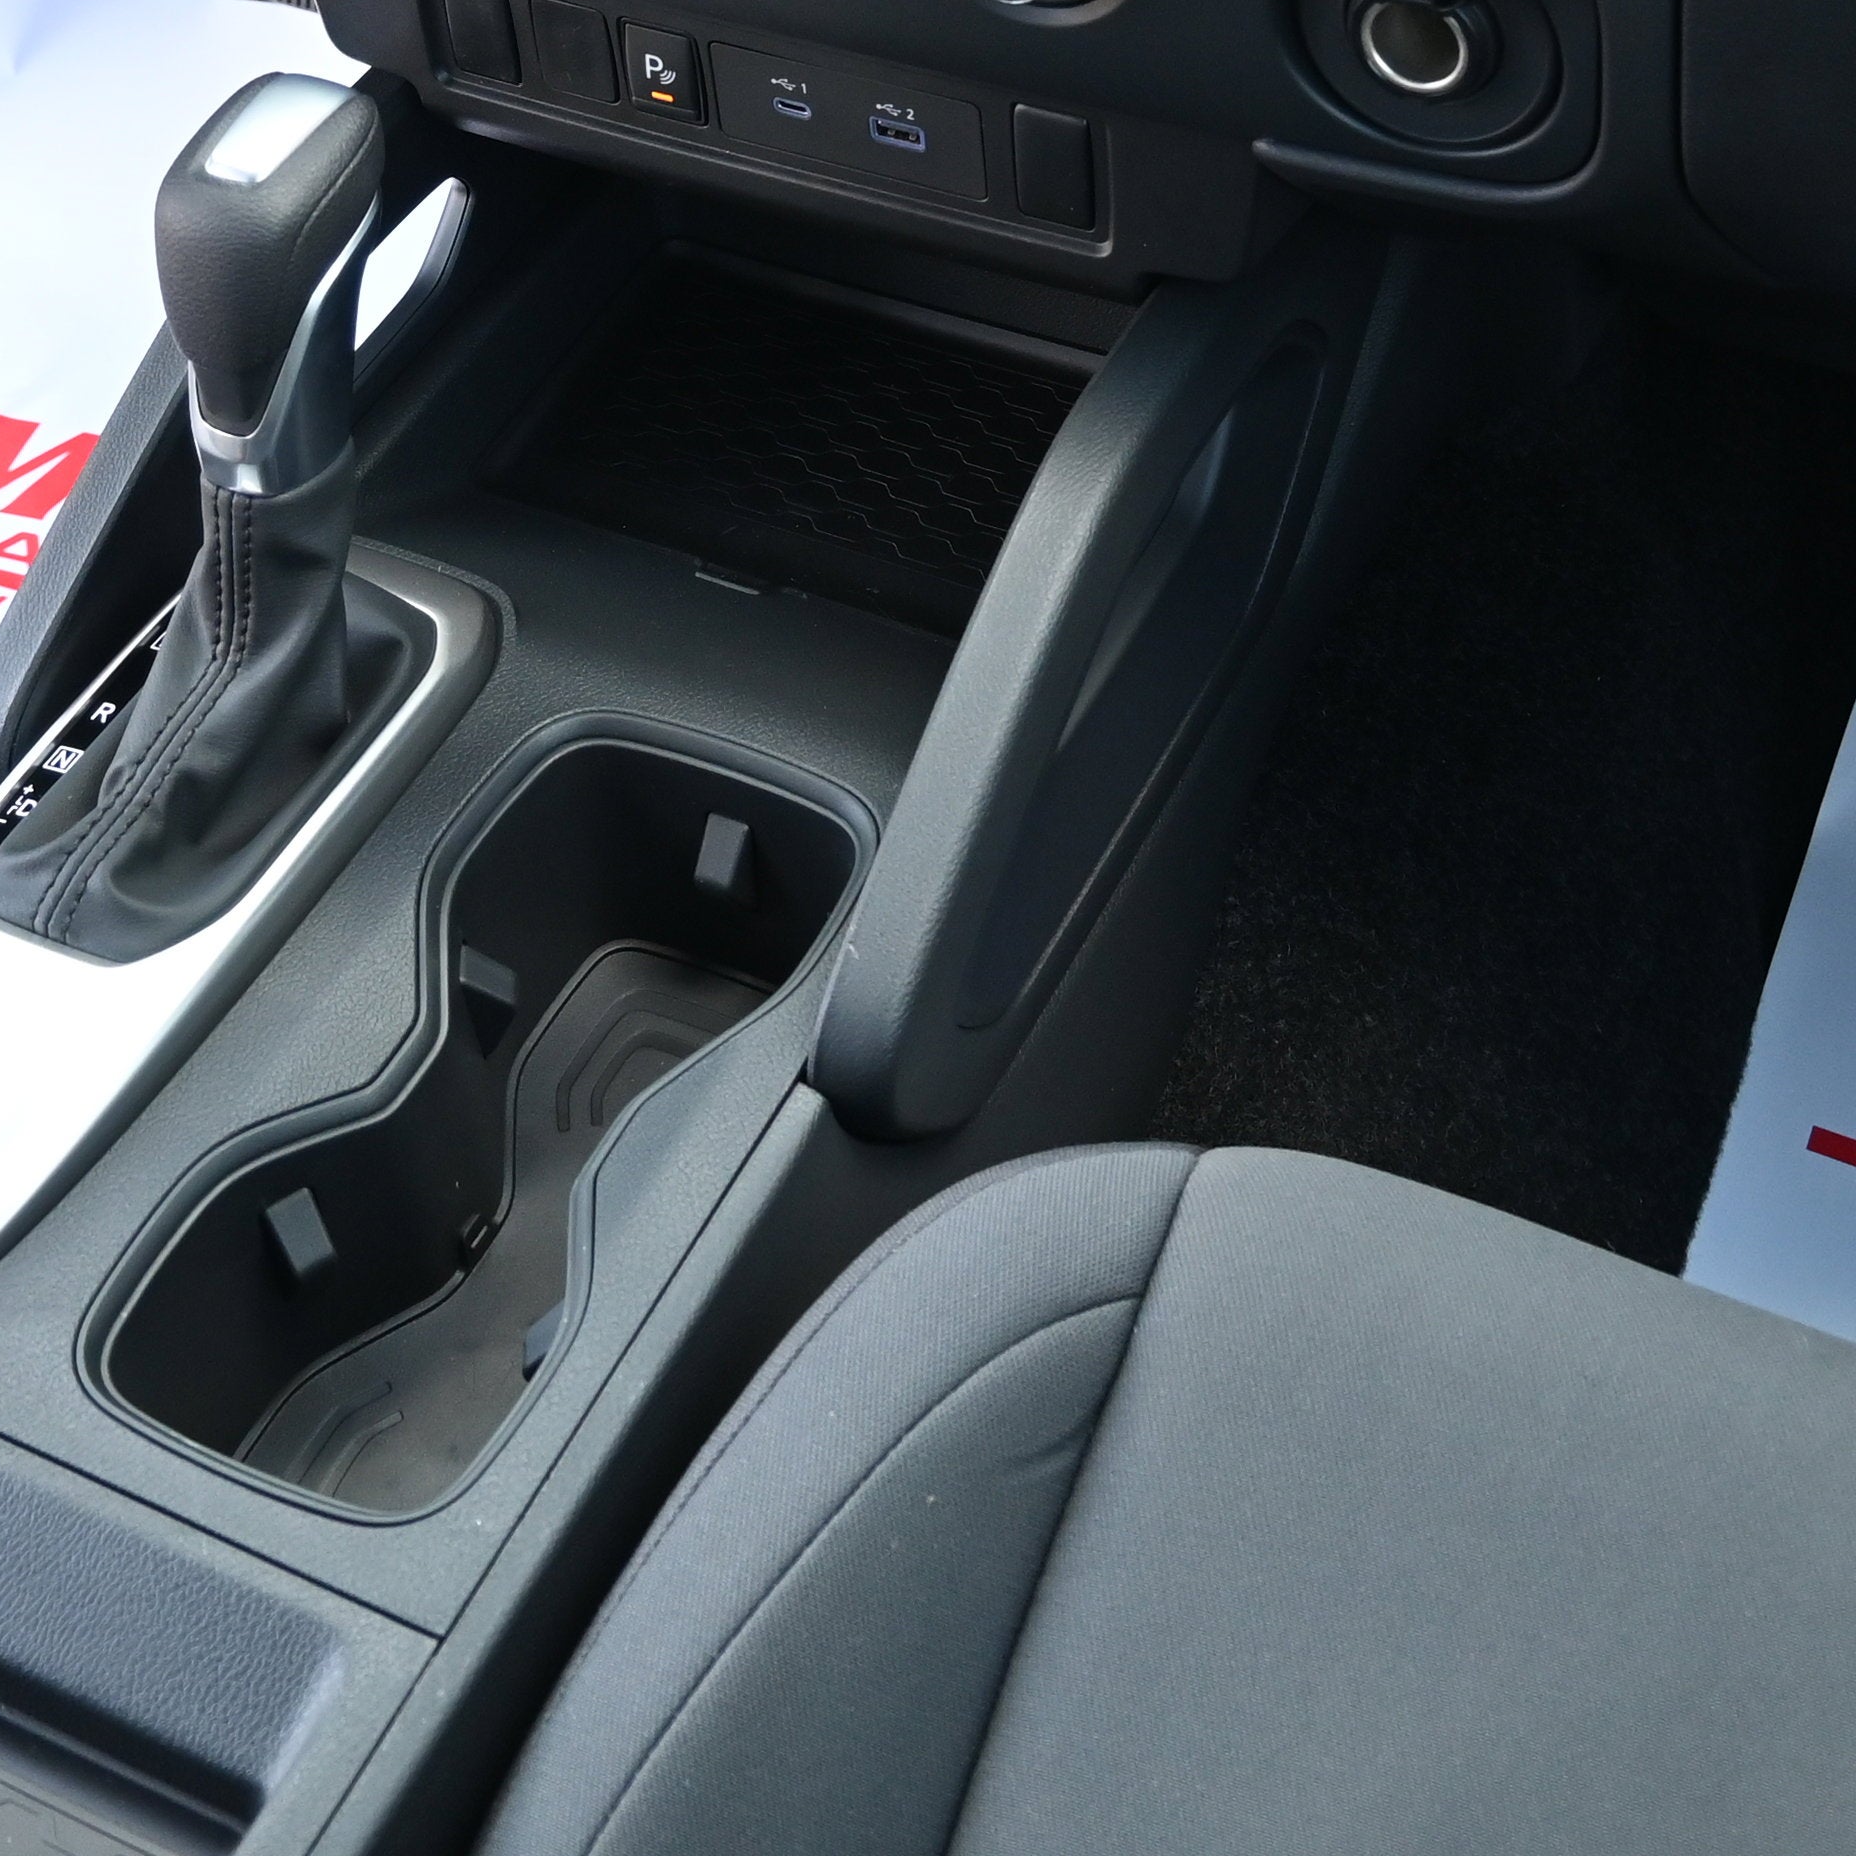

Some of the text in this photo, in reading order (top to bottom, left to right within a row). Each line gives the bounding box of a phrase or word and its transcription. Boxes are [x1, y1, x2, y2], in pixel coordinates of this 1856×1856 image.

[644, 52, 664, 80] P
[905, 107, 916, 122] 2
[90, 702, 117, 725] R
[49, 748, 76, 769] N
